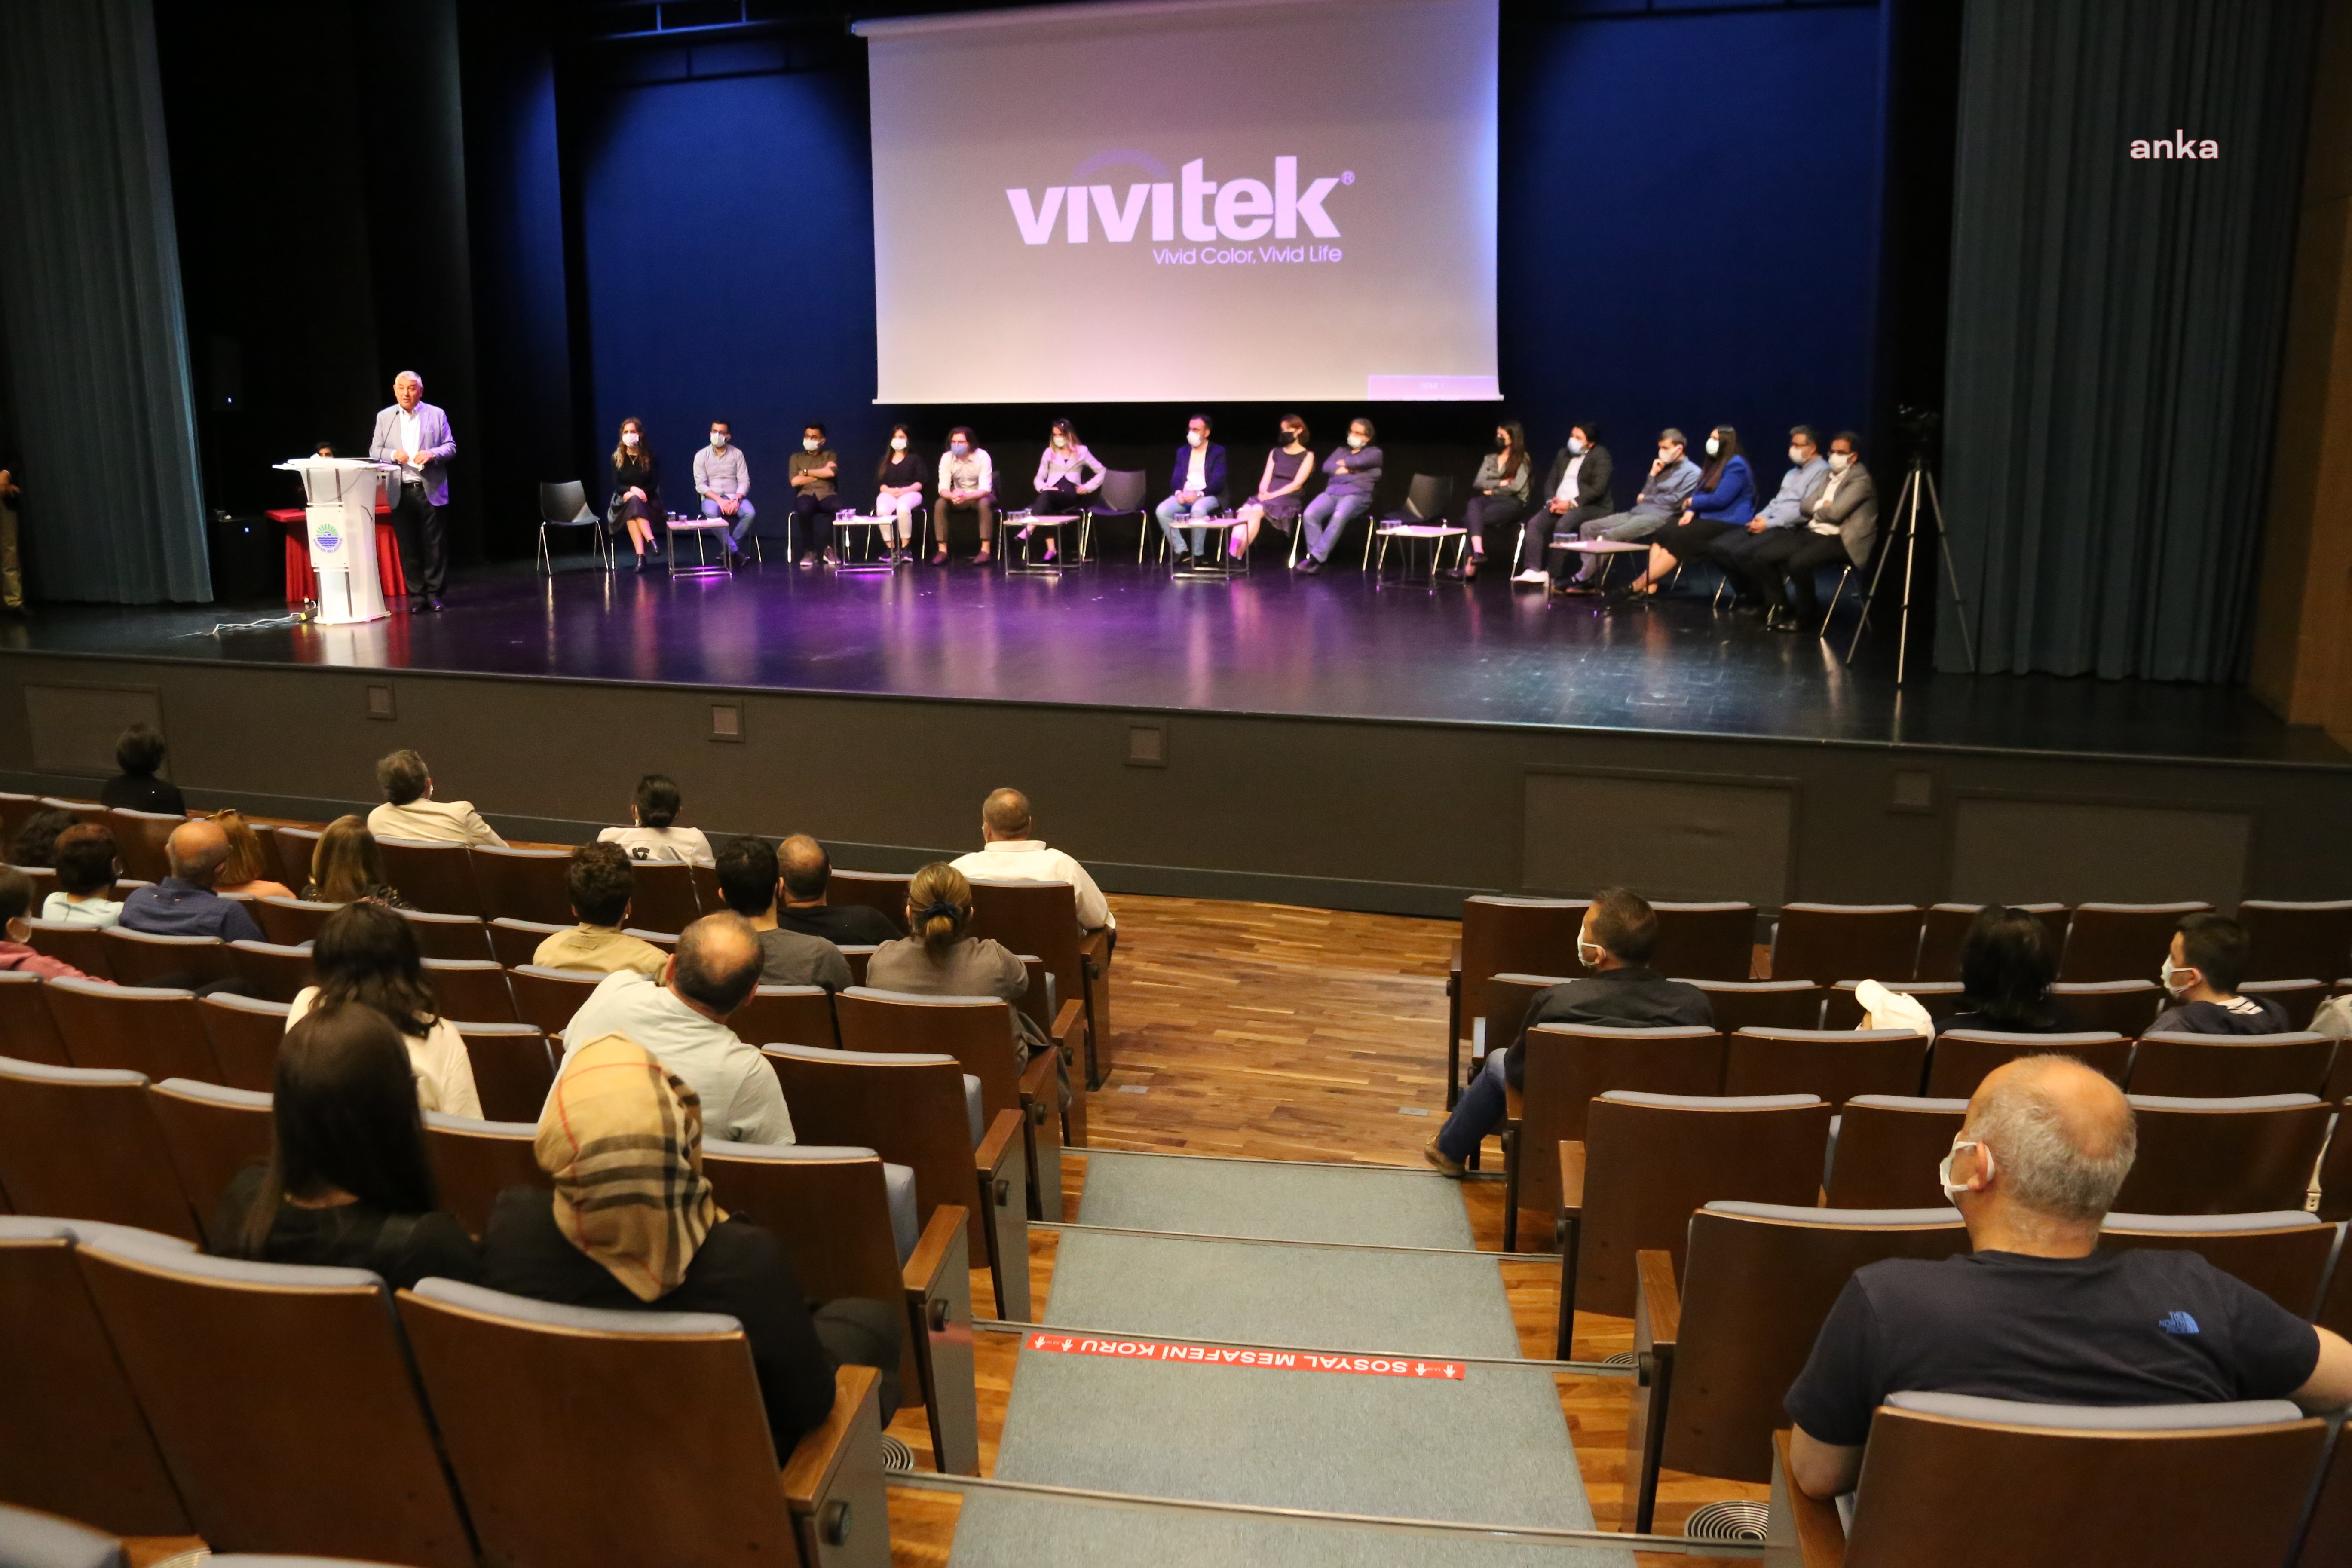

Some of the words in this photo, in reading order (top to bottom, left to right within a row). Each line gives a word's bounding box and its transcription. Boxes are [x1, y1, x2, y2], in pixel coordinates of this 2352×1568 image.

[1152, 248, 1197, 264] Vivid
[1201, 247, 1256, 264] Color,
[1259, 246, 1304, 263] Vivid
[1310, 245, 1343, 262] Life
[1080, 1340, 1155, 1356] KORU
[1161, 1345, 1295, 1366] MESAFENİ
[1304, 1355, 1408, 1373] SOSYAL
